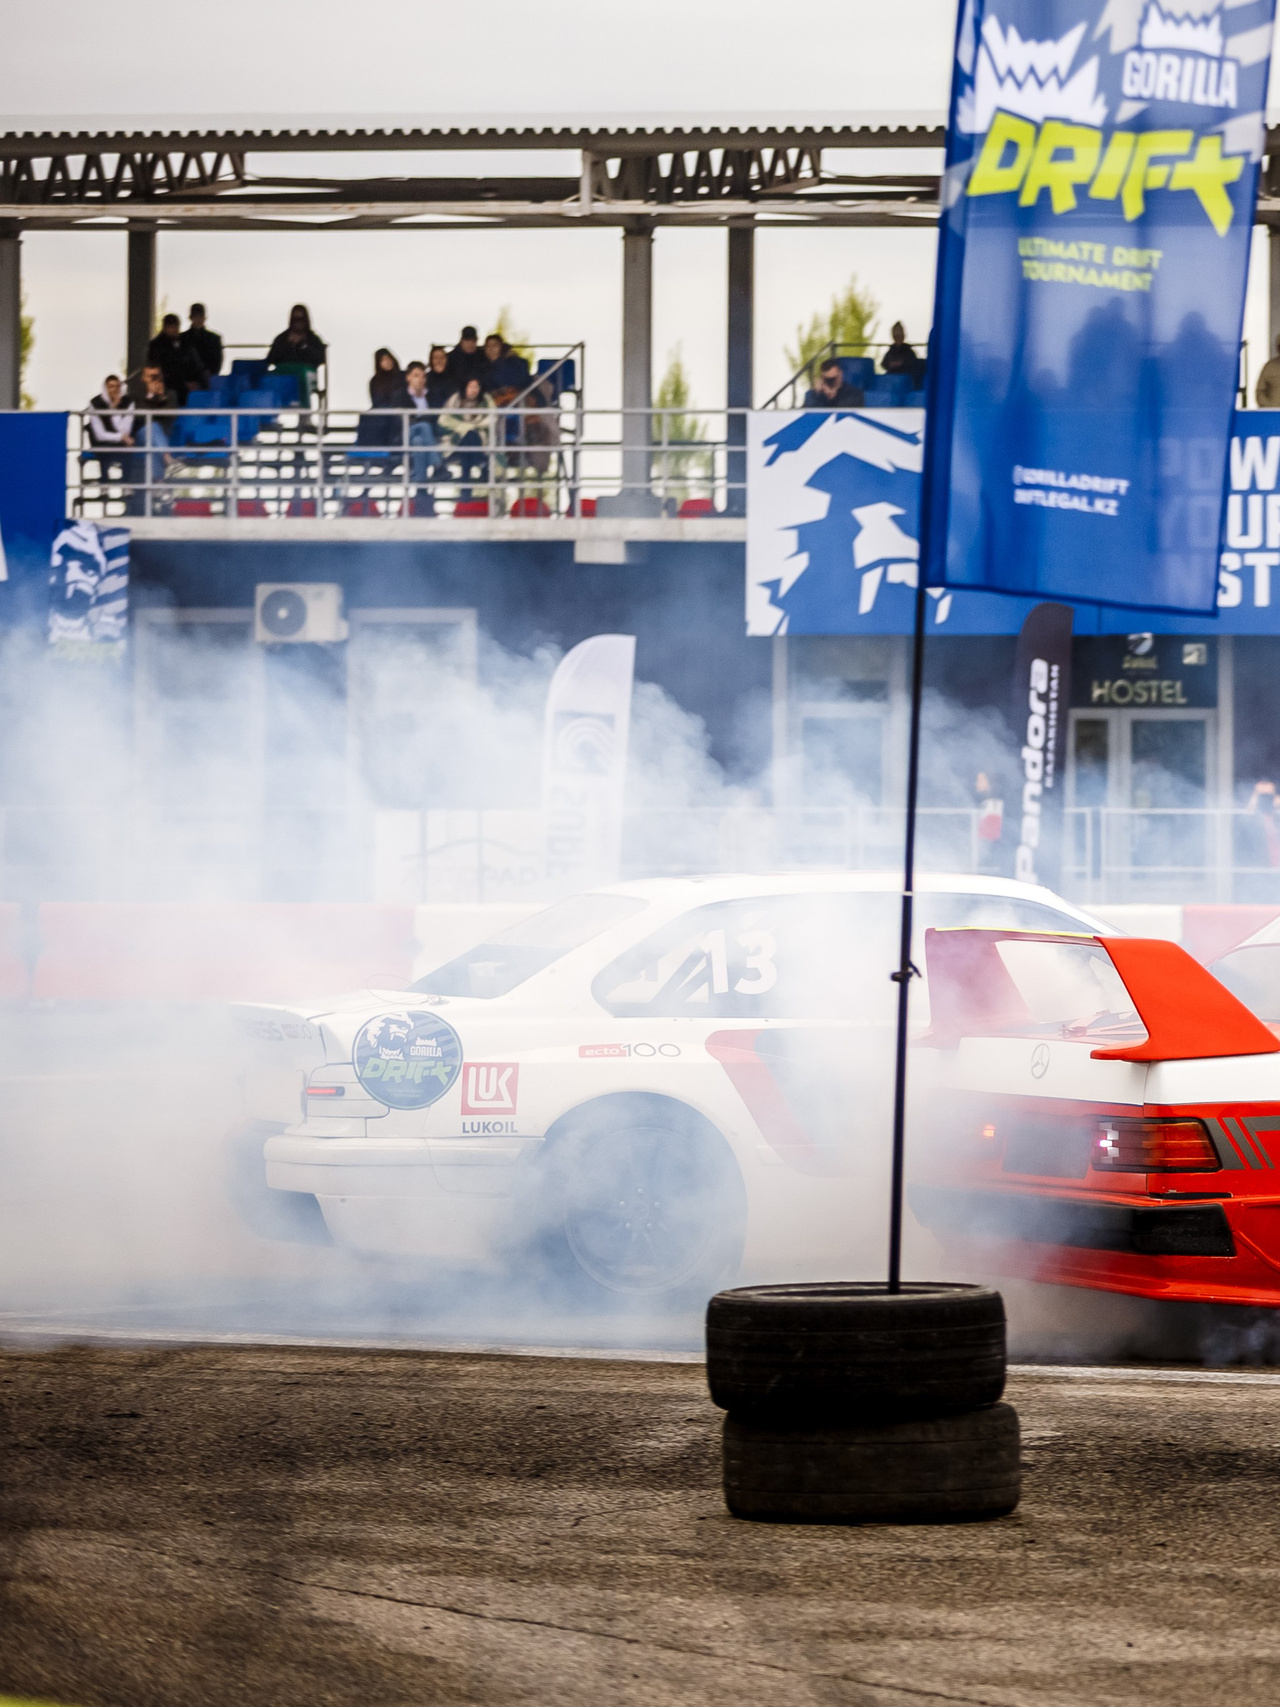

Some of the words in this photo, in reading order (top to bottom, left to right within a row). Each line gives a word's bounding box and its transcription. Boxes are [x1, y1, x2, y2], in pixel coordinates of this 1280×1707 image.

[1122, 51, 1238, 108] GORILLA
[1112, 245, 1163, 269] DRIFT
[1022, 260, 1153, 292] TOURNAMENT
[1091, 679, 1188, 704] HOSTEL
[410, 1046, 442, 1058] GORILLA
[462, 1121, 518, 1134] LUKOIL
